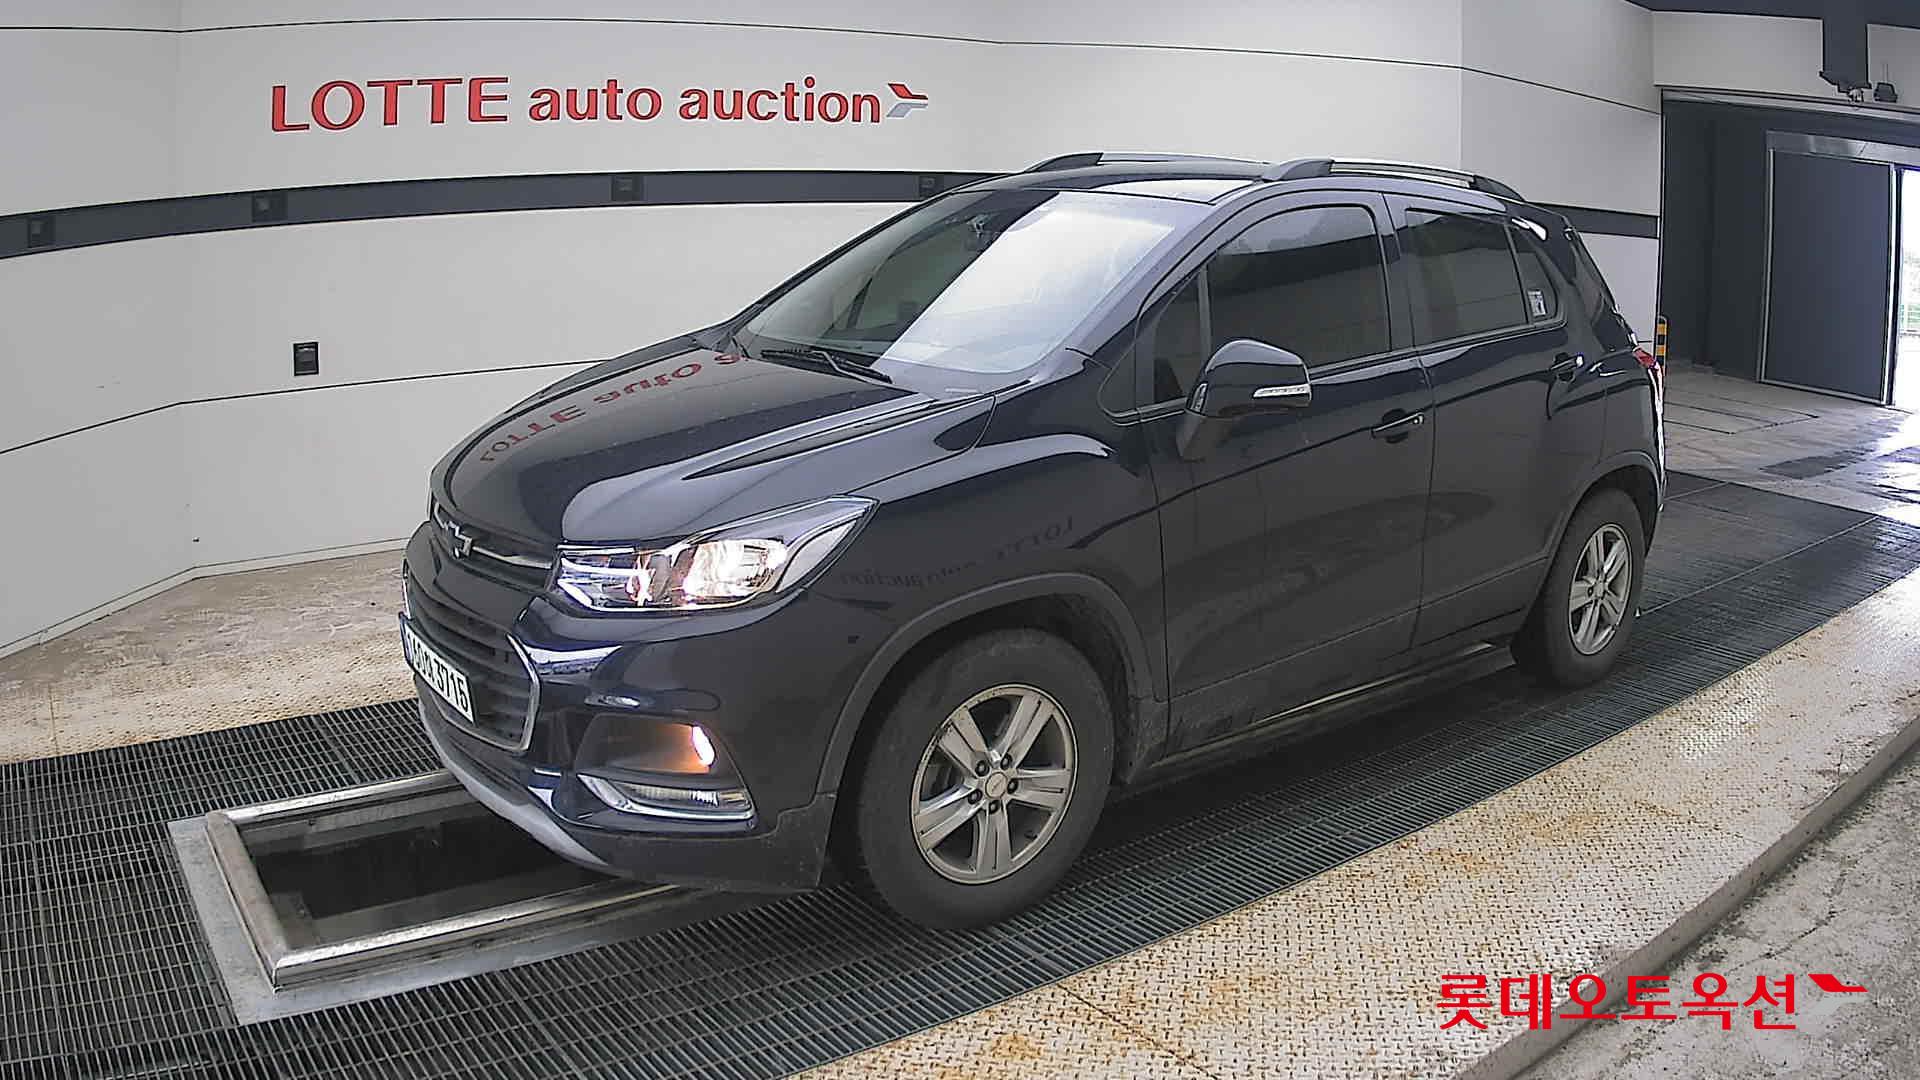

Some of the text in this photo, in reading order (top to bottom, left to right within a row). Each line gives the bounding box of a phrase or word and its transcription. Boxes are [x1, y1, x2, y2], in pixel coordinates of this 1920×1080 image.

[271, 76, 881, 132] LOTTE auto auction
